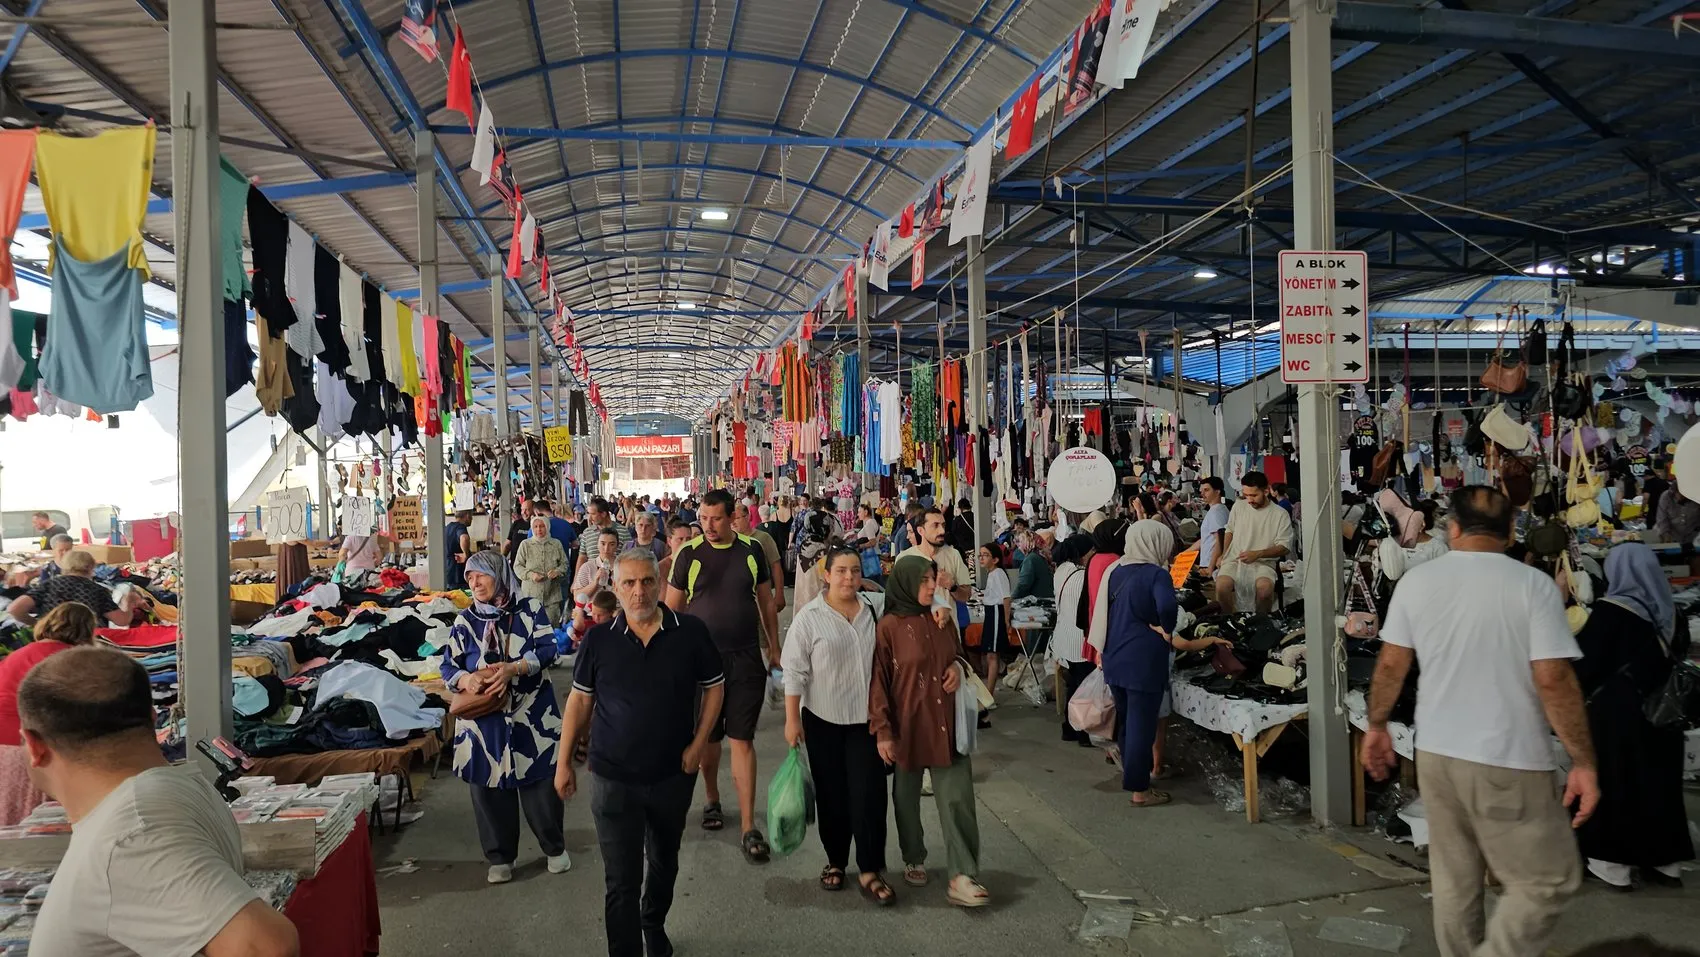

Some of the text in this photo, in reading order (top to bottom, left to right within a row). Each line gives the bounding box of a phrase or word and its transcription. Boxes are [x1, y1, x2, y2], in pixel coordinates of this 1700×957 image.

[1296, 259, 1346, 269] A BLOK
[1286, 305, 1333, 317] ZABITA
[1286, 333, 1336, 345] MESCT
[1287, 360, 1311, 372] WC
[551, 443, 572, 459] 850
[616, 445, 651, 455] BALKAN
[652, 444, 680, 454] PAZARI
[270, 502, 303, 538] 500
